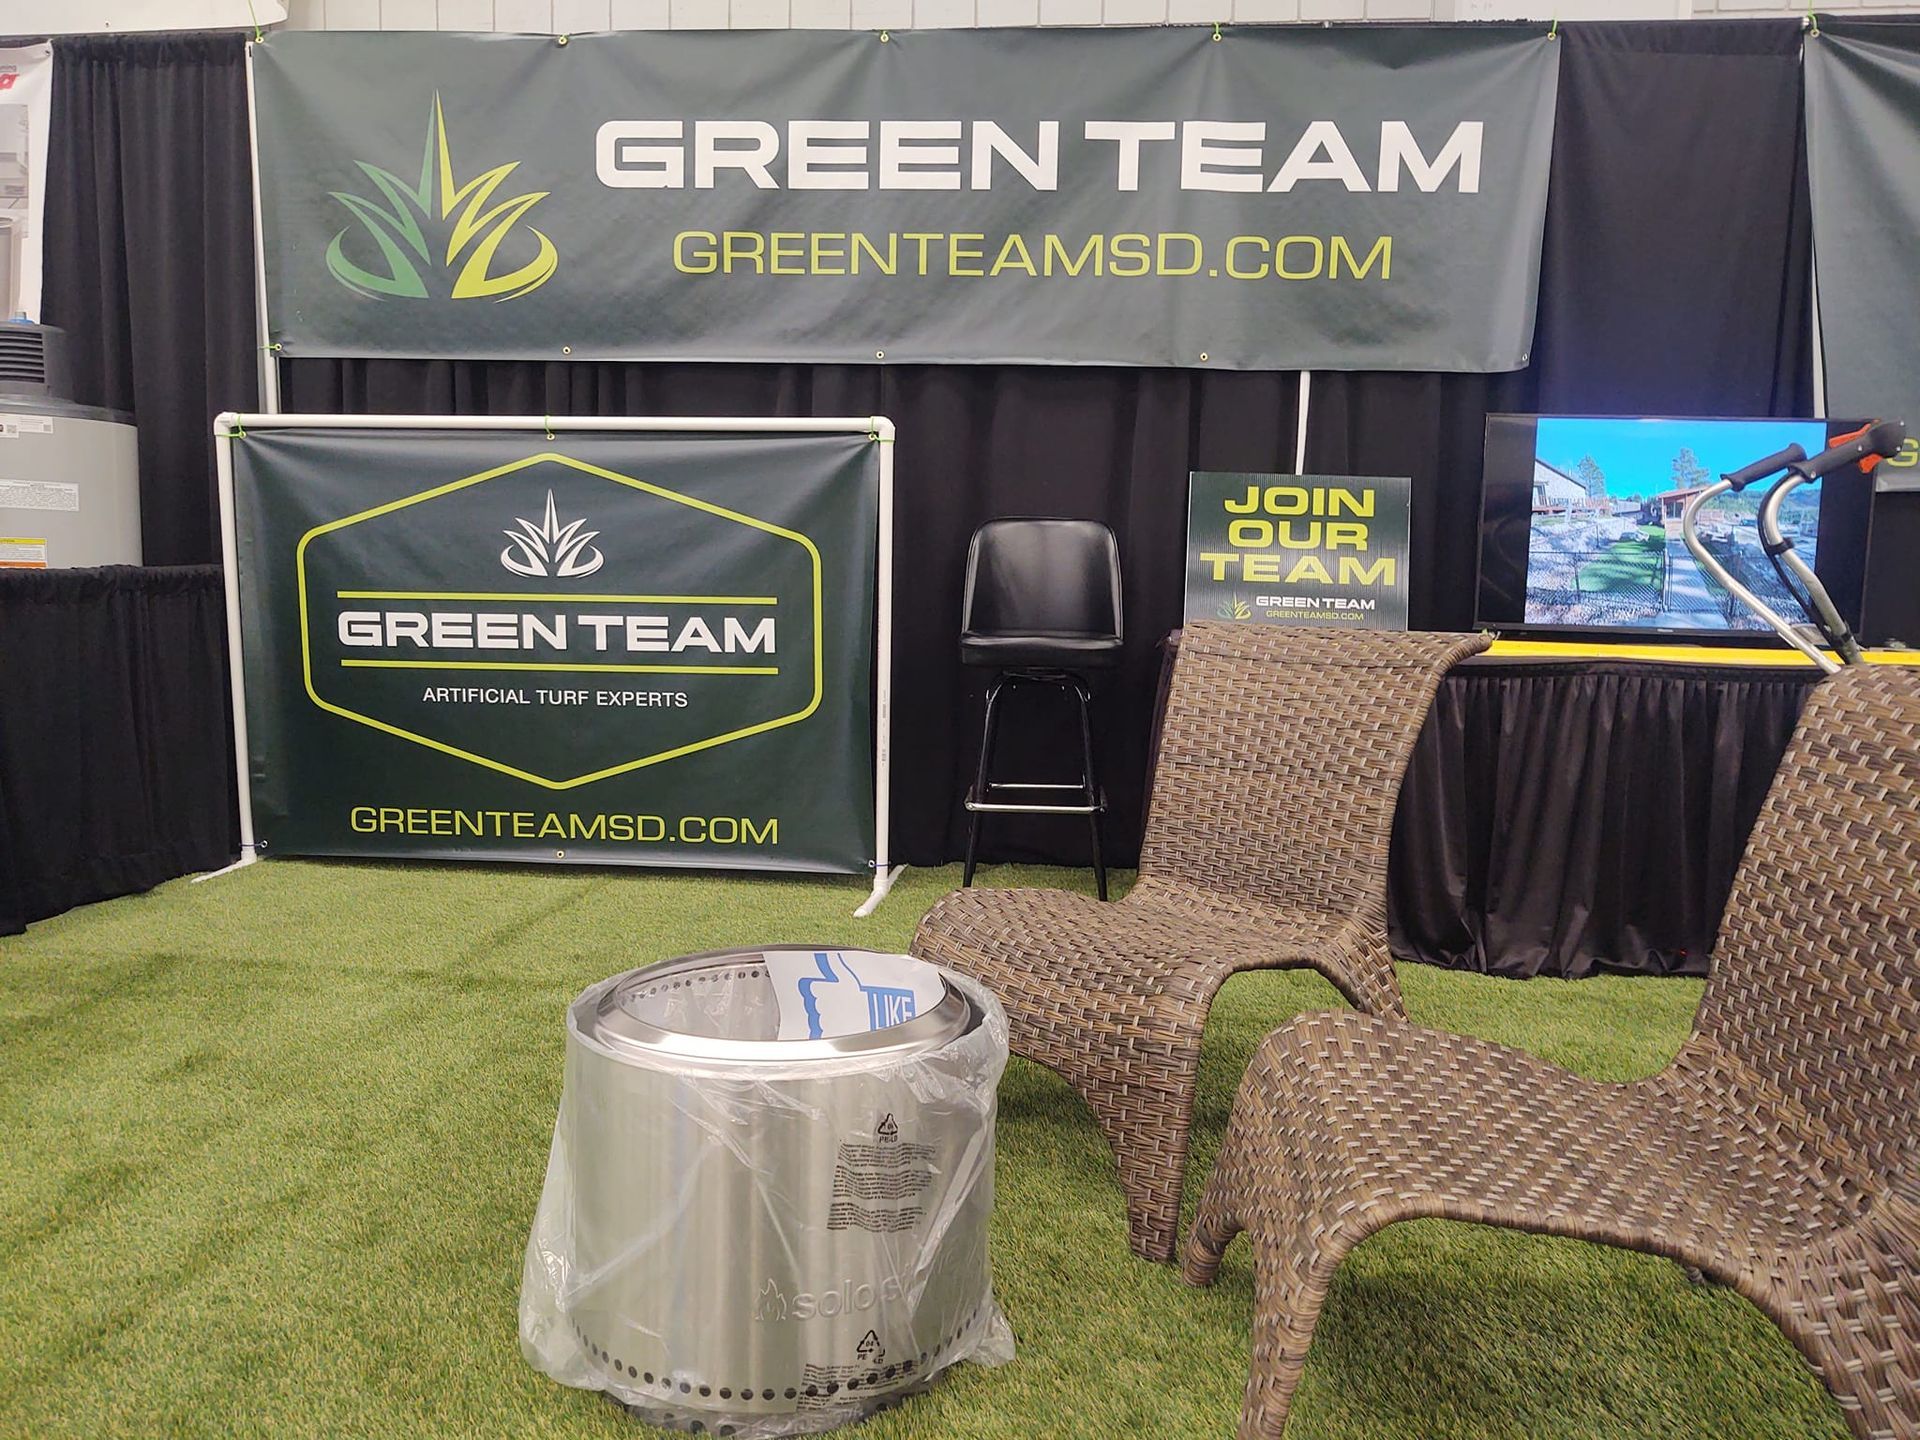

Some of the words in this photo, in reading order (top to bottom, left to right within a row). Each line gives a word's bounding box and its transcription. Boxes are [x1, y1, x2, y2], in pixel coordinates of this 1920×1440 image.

[596, 120, 1060, 191] GREEN
[1085, 121, 1484, 194] TEAM
[672, 230, 1393, 280] GREENTEAMSD.COM
[1224, 485, 1375, 517] JOIN
[1228, 519, 1369, 551] OUR
[1200, 552, 1396, 586] TEAM
[1256, 596, 1320, 608] GREEN
[1322, 598, 1376, 610] TEAM
[1265, 610, 1365, 621] GREENTEAMSD.COM
[338, 611, 568, 650] GREEN
[578, 615, 777, 653] TEAM
[422, 687, 531, 704] ARTIFICIAL
[536, 689, 590, 705] TURF
[597, 691, 688, 707] EXPERTS
[351, 806, 778, 845] GREENTEAMSD.COM
[873, 992, 913, 1031] LIKE
[793, 1279, 876, 1319] solo
